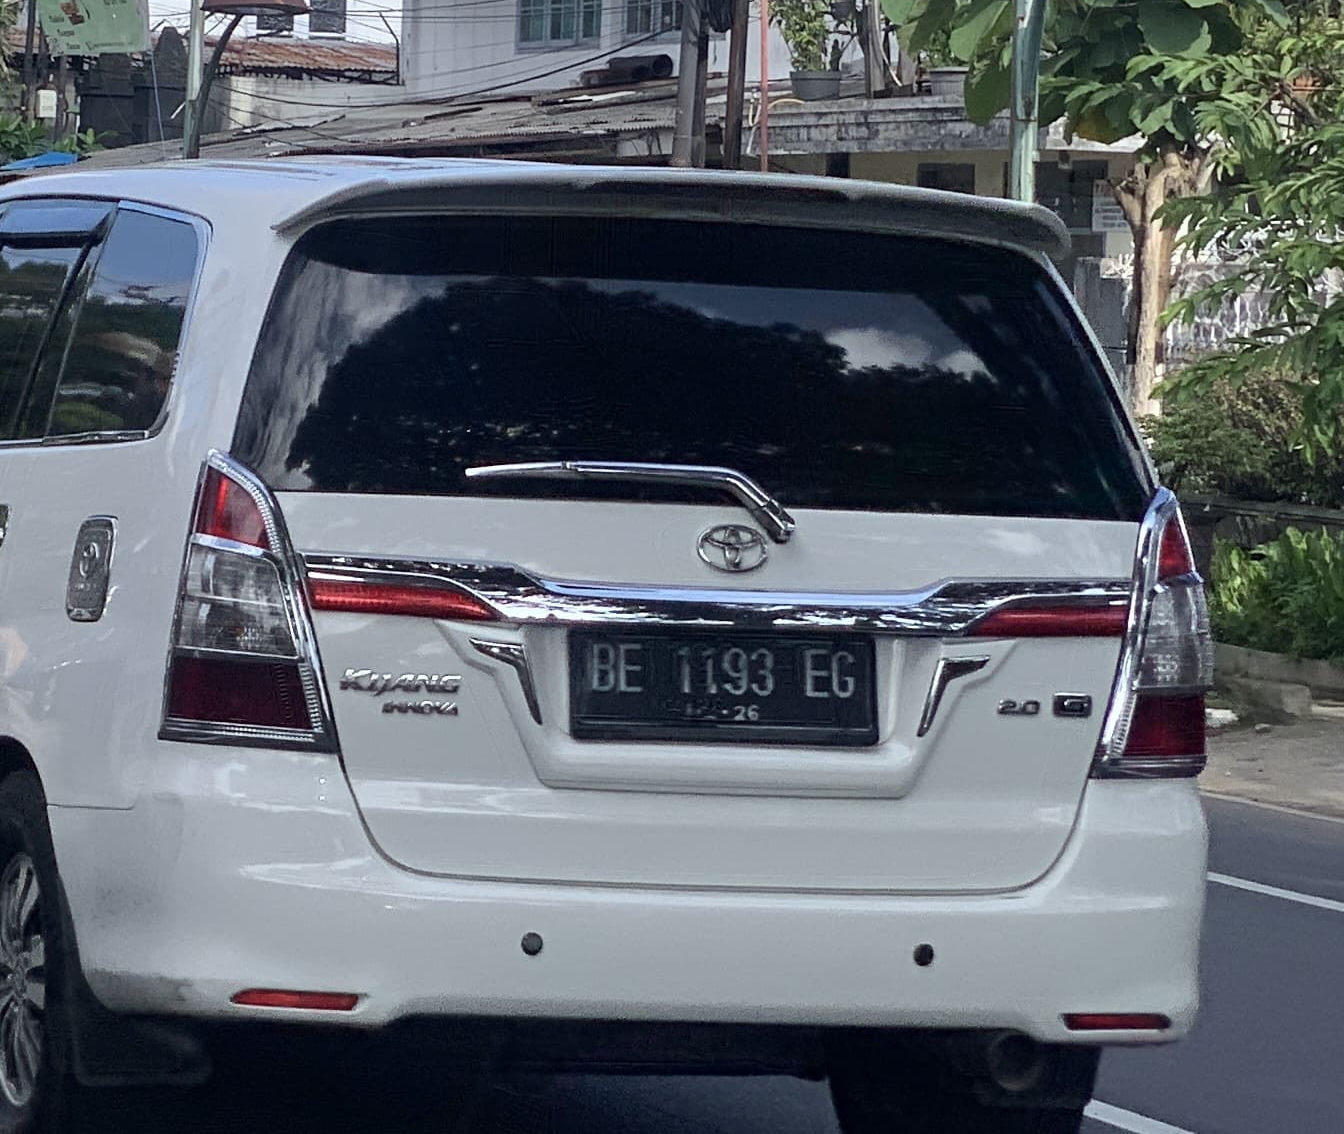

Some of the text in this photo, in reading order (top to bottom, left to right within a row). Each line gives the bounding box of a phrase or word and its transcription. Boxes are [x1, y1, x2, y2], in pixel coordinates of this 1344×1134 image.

[590, 642, 857, 699] BE 1193 EG
[381, 700, 459, 716] INNOVA
